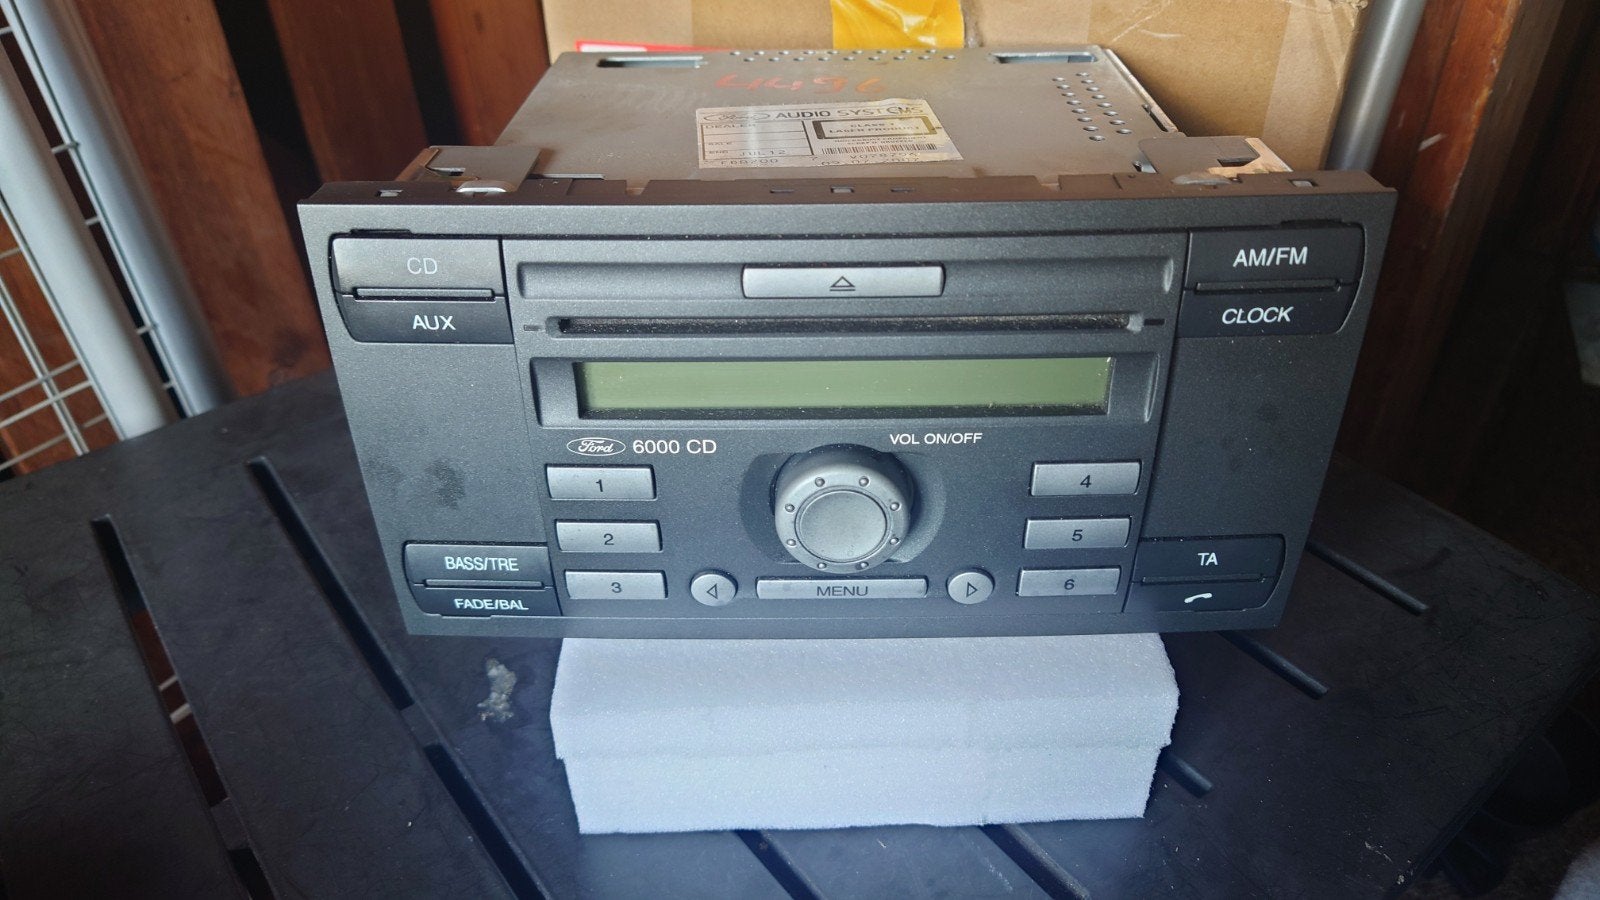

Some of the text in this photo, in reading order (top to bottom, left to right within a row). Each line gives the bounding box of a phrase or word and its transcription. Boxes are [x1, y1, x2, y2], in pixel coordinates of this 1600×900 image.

[776, 110, 831, 120] AUDIO
[1232, 246, 1308, 268] AM/FM
[406, 257, 438, 275] CD
[412, 314, 456, 331] AUX
[1222, 306, 1294, 325] CLOCK
[889, 432, 983, 445] VOL ON/OFF
[632, 439, 680, 454] 6000
[686, 439, 717, 454] CD
[595, 478, 604, 493] 1
[1079, 474, 1092, 488] 4
[602, 533, 615, 546] 2
[1071, 529, 1083, 542] 5
[444, 556, 520, 572] BASS/TRE
[1197, 552, 1219, 566] TA
[610, 581, 623, 594] 3
[816, 585, 869, 597] MENU
[1063, 578, 1075, 591] 6
[453, 598, 530, 611] FADE/BAL
